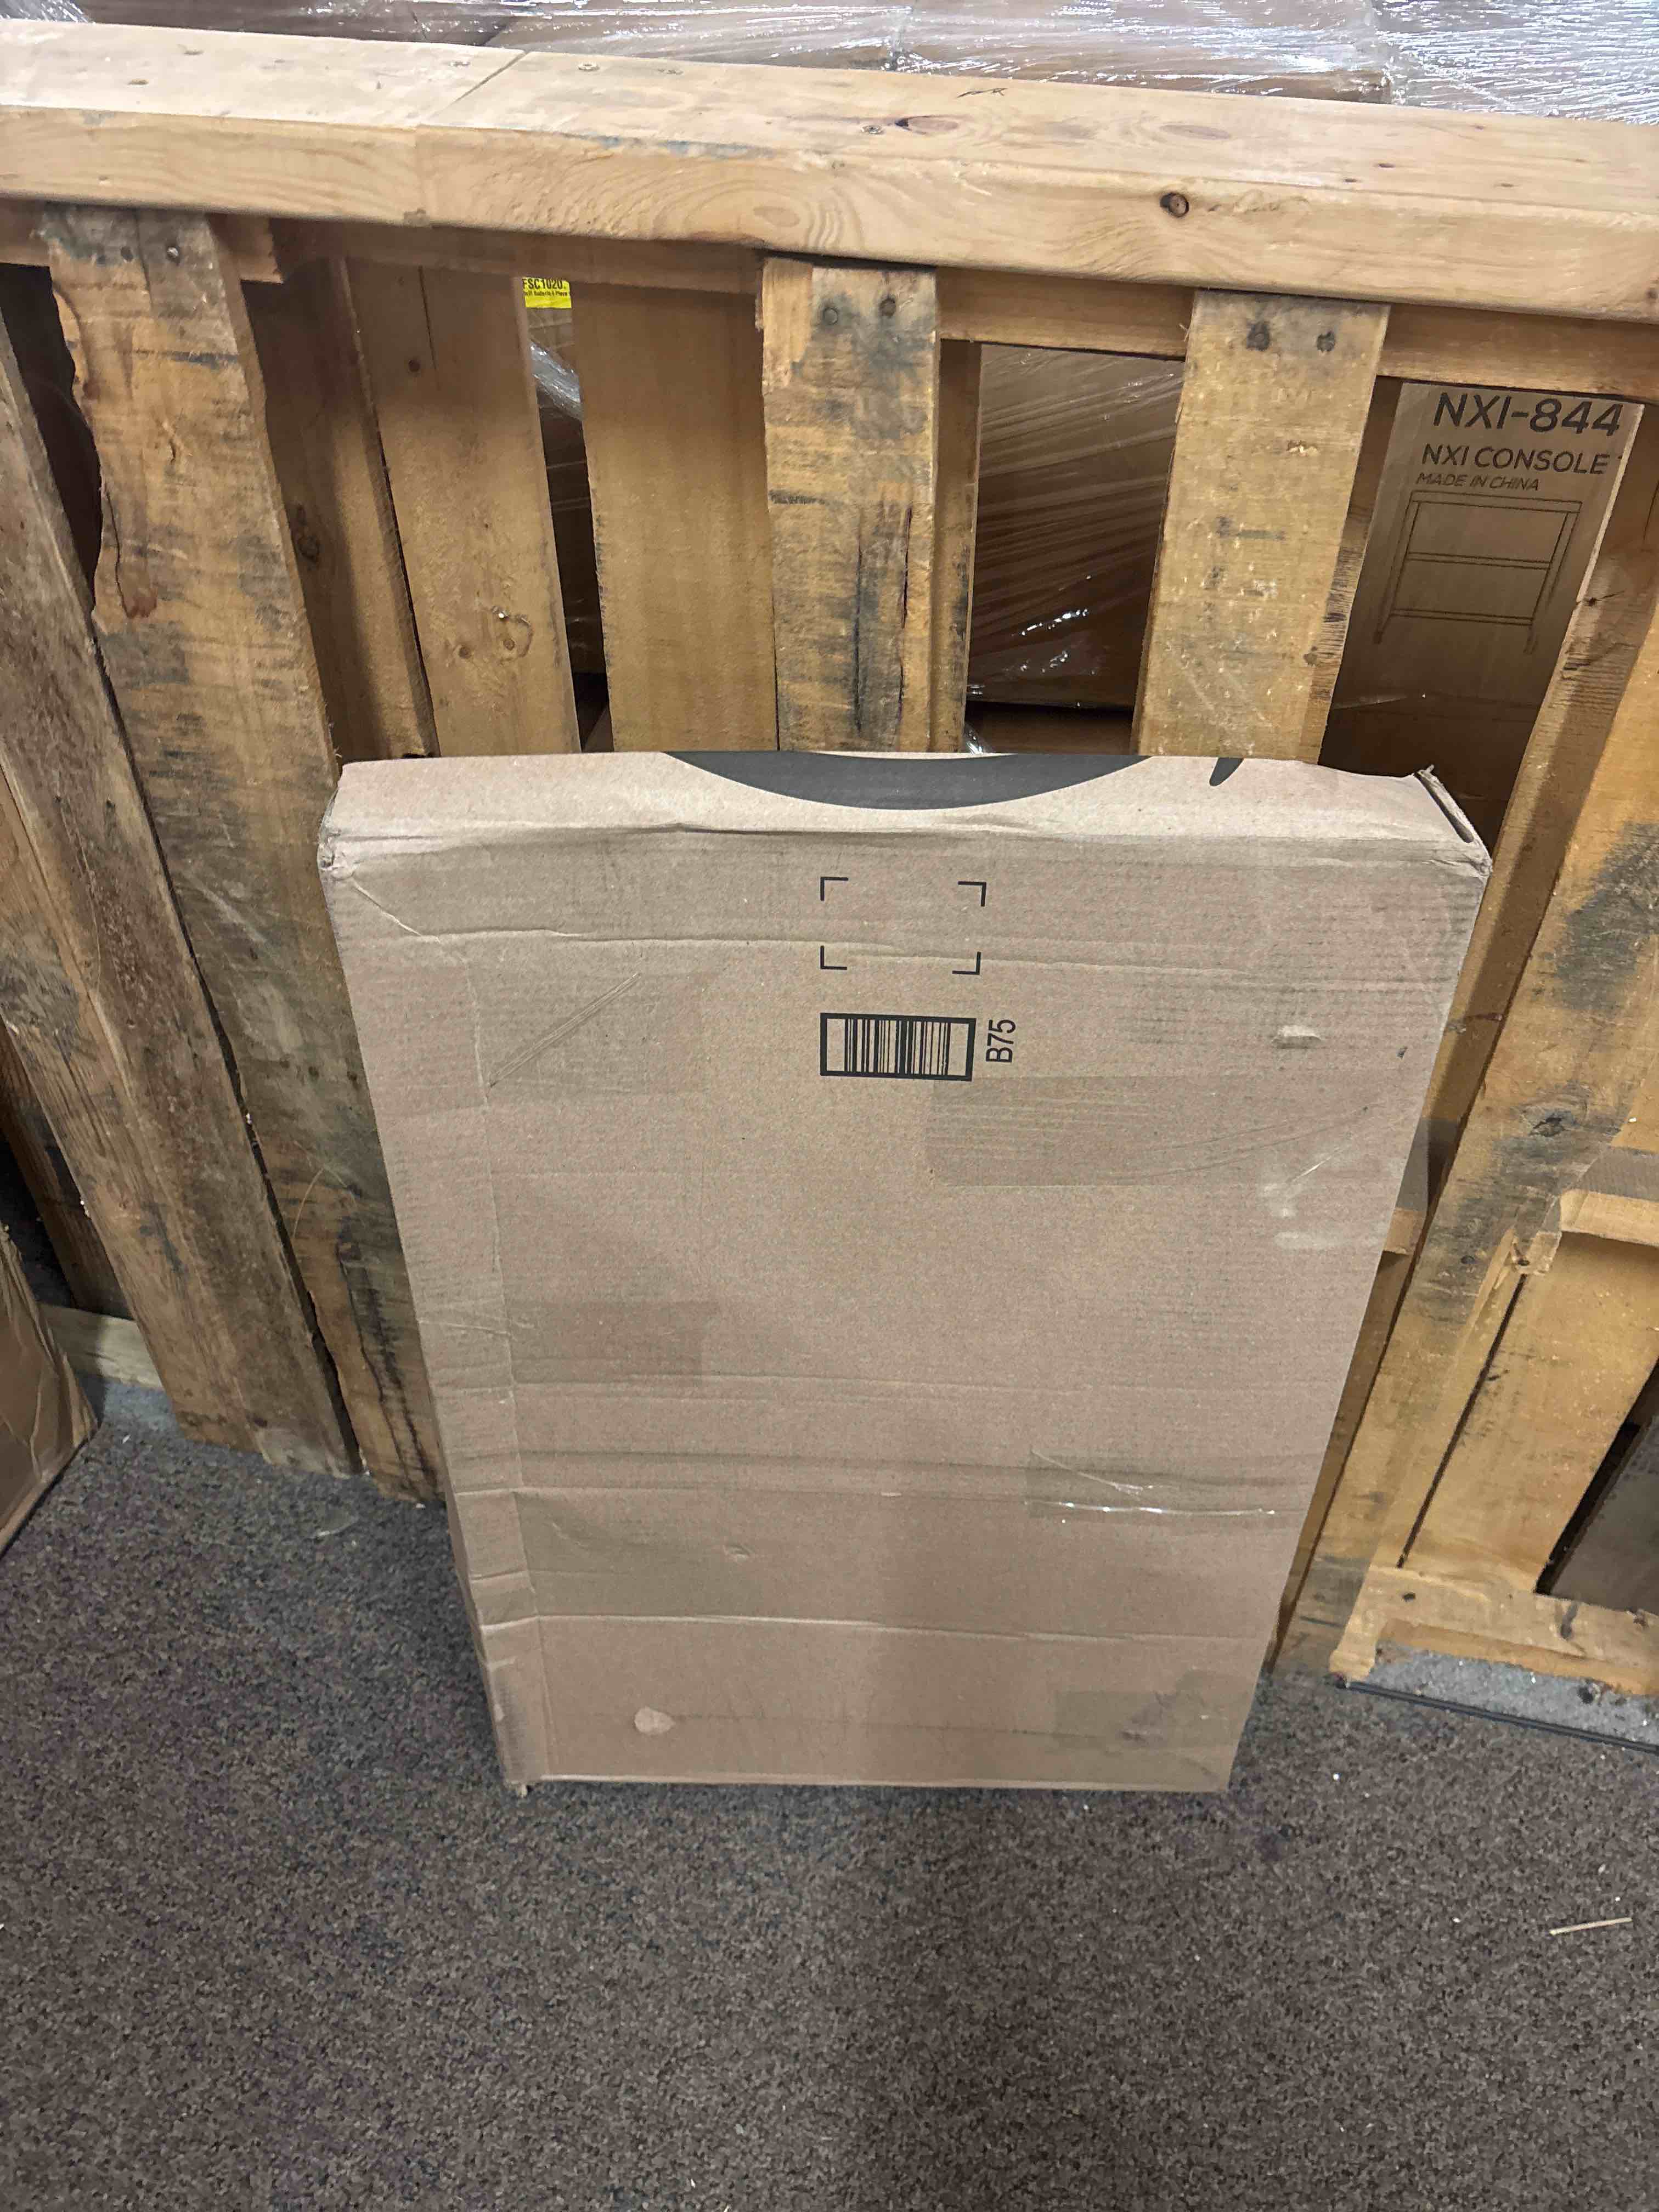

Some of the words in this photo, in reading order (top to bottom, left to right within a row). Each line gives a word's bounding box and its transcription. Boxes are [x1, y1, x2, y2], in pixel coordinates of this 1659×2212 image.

[1433, 392, 1623, 436] NXI-844
[1421, 443, 1470, 466] NXI
[1474, 446, 1610, 475] CONSOLE
[1415, 472, 1468, 488] MADE
[1470, 474, 1486, 488] IN
[1489, 476, 1540, 491] CHINA
[985, 1019, 1016, 1063] B75
